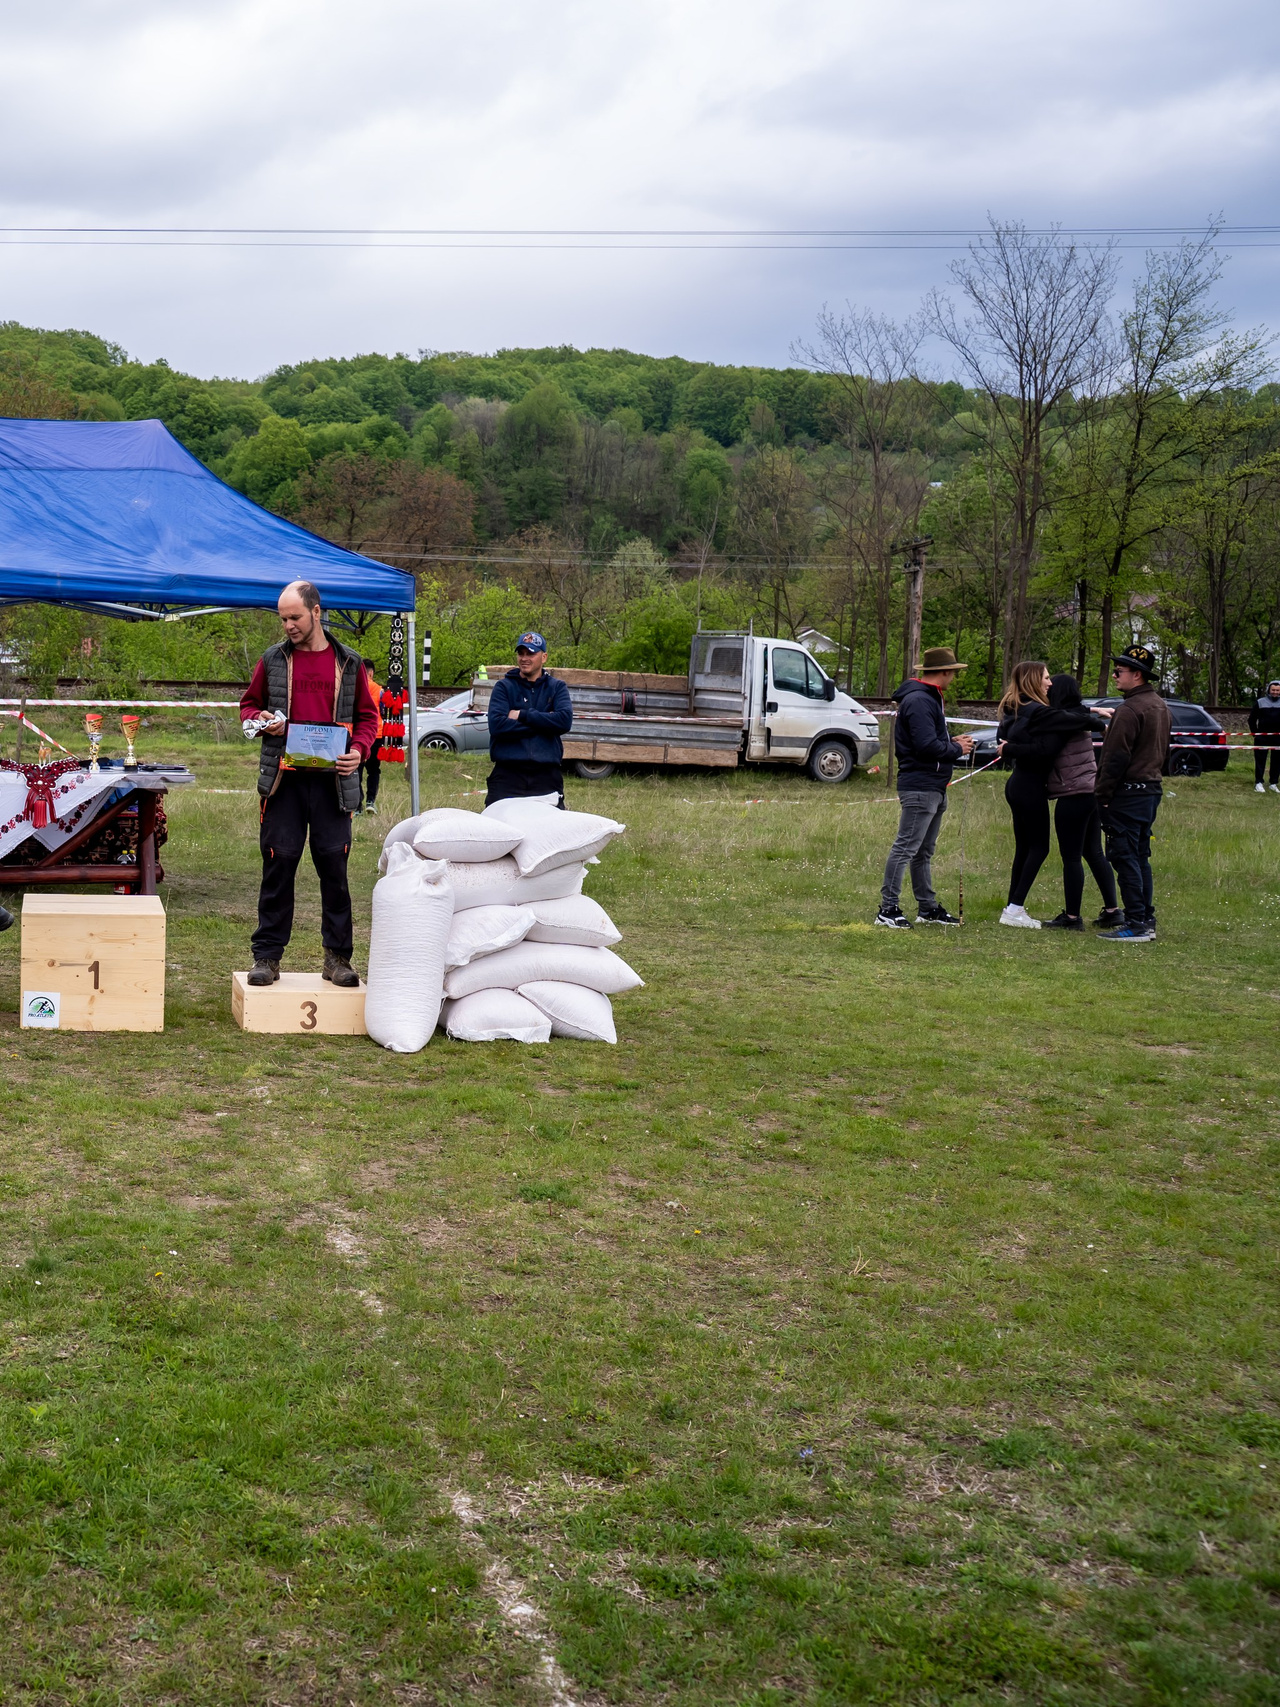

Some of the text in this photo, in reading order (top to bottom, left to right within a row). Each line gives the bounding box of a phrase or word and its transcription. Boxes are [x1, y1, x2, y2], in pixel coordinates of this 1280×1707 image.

[294, 680, 334, 691] LIFORNI
[88, 961, 99, 989] 1
[300, 1001, 317, 1030] 3
